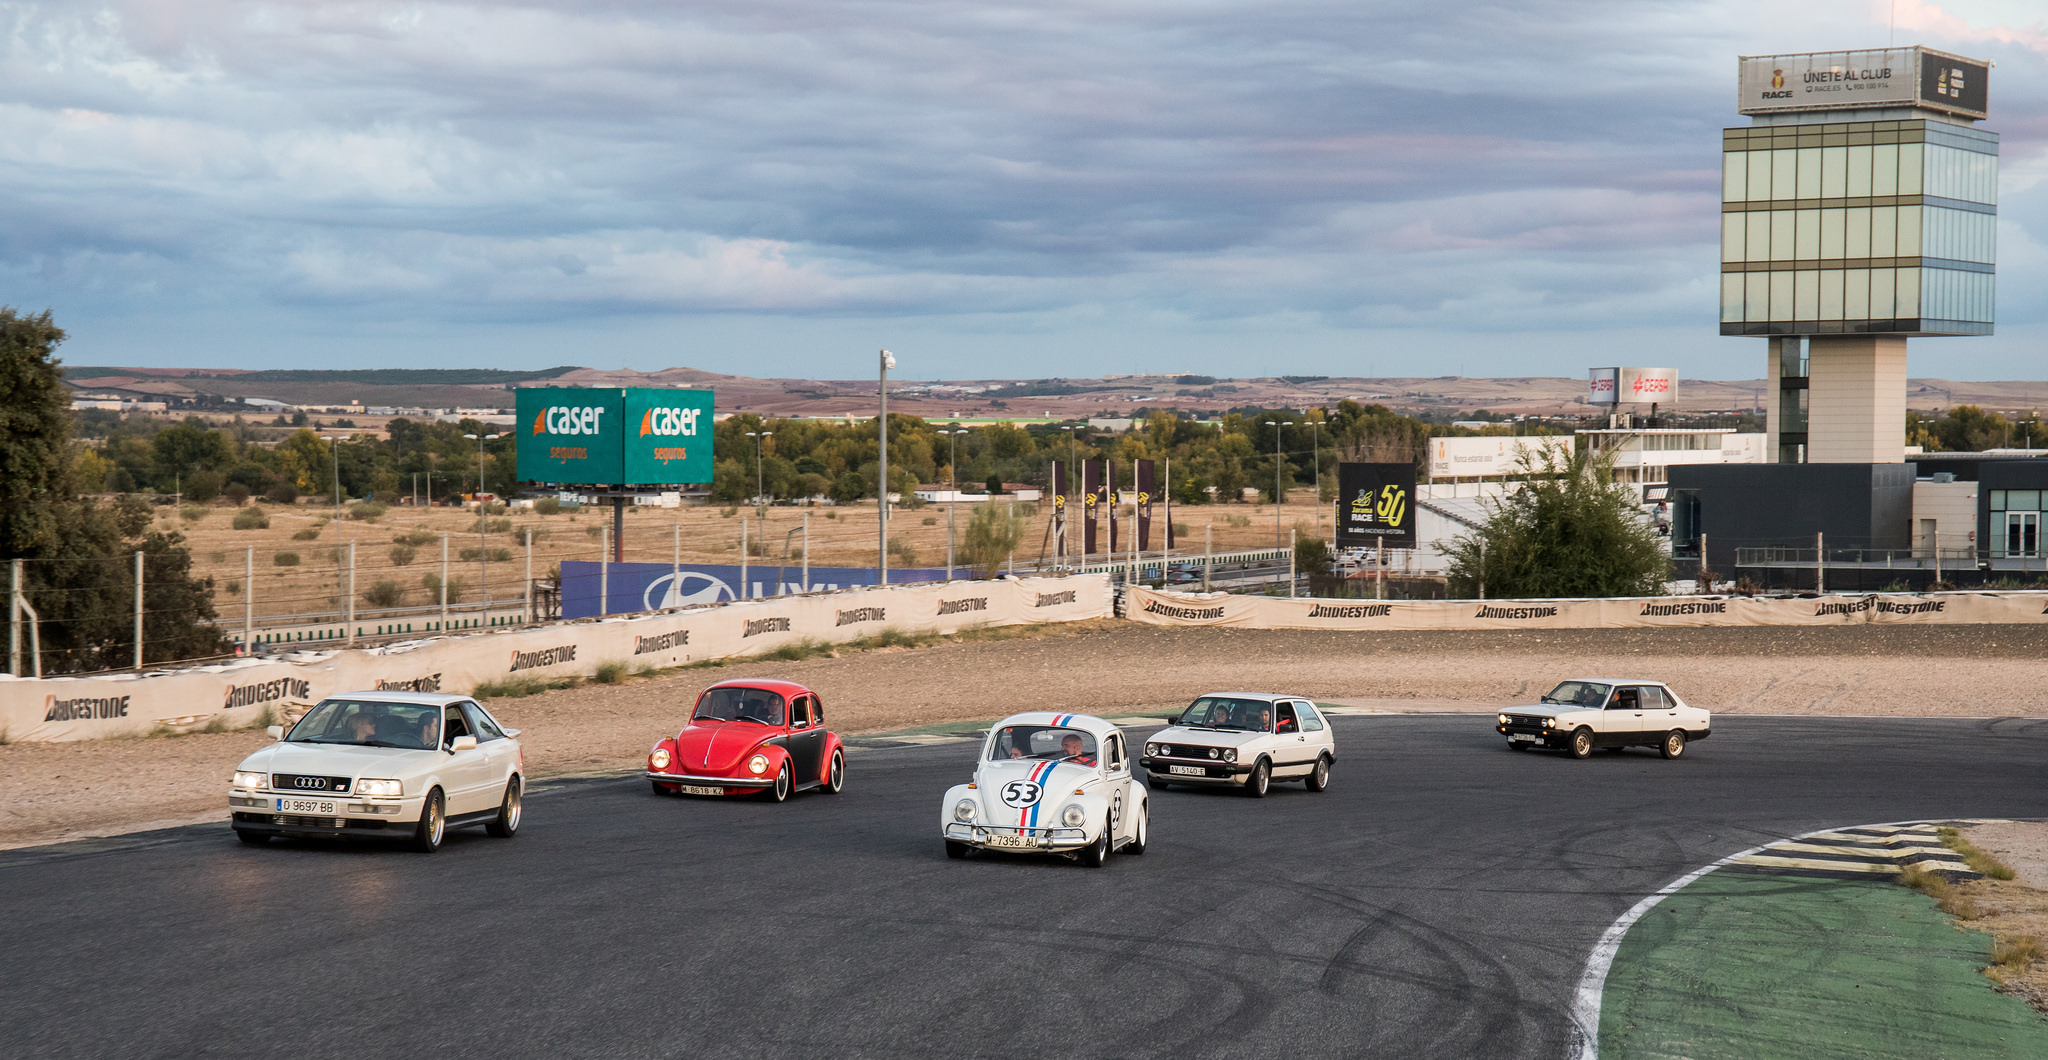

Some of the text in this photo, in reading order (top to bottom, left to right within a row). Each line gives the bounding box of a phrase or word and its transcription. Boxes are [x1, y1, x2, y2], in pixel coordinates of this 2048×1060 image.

[1803, 68, 1892, 83] ÚNETE AL CLUB
[1762, 91, 1793, 99] RACE
[1644, 378, 1669, 392] CEPSA
[547, 406, 604, 435] caser
[652, 407, 701, 436] caser
[550, 446, 587, 464] seguros
[653, 447, 687, 465] seguros
[1085, 493, 1097, 507] 50
[1377, 485, 1405, 527] 50
[1352, 514, 1373, 522] RACE
[937, 597, 988, 616] BRIDGESTONE
[1144, 598, 1225, 620] BRIDGESTONE
[1307, 603, 1392, 618] BRIDGESTONE
[1474, 604, 1558, 619] BRIDGESTONE
[1639, 602, 1726, 616] BRIDGESTONE
[835, 607, 886, 627] BRIDGESTONE
[742, 617, 790, 638] BRIDGESTONE
[634, 629, 690, 656] BRIDGESTONE
[510, 644, 577, 672] BRIDGESTONE
[1006, 783, 1039, 802] 53
[293, 801, 317, 812] 9697
[320, 802, 333, 813] BB
[1113, 796, 1121, 823] 53
